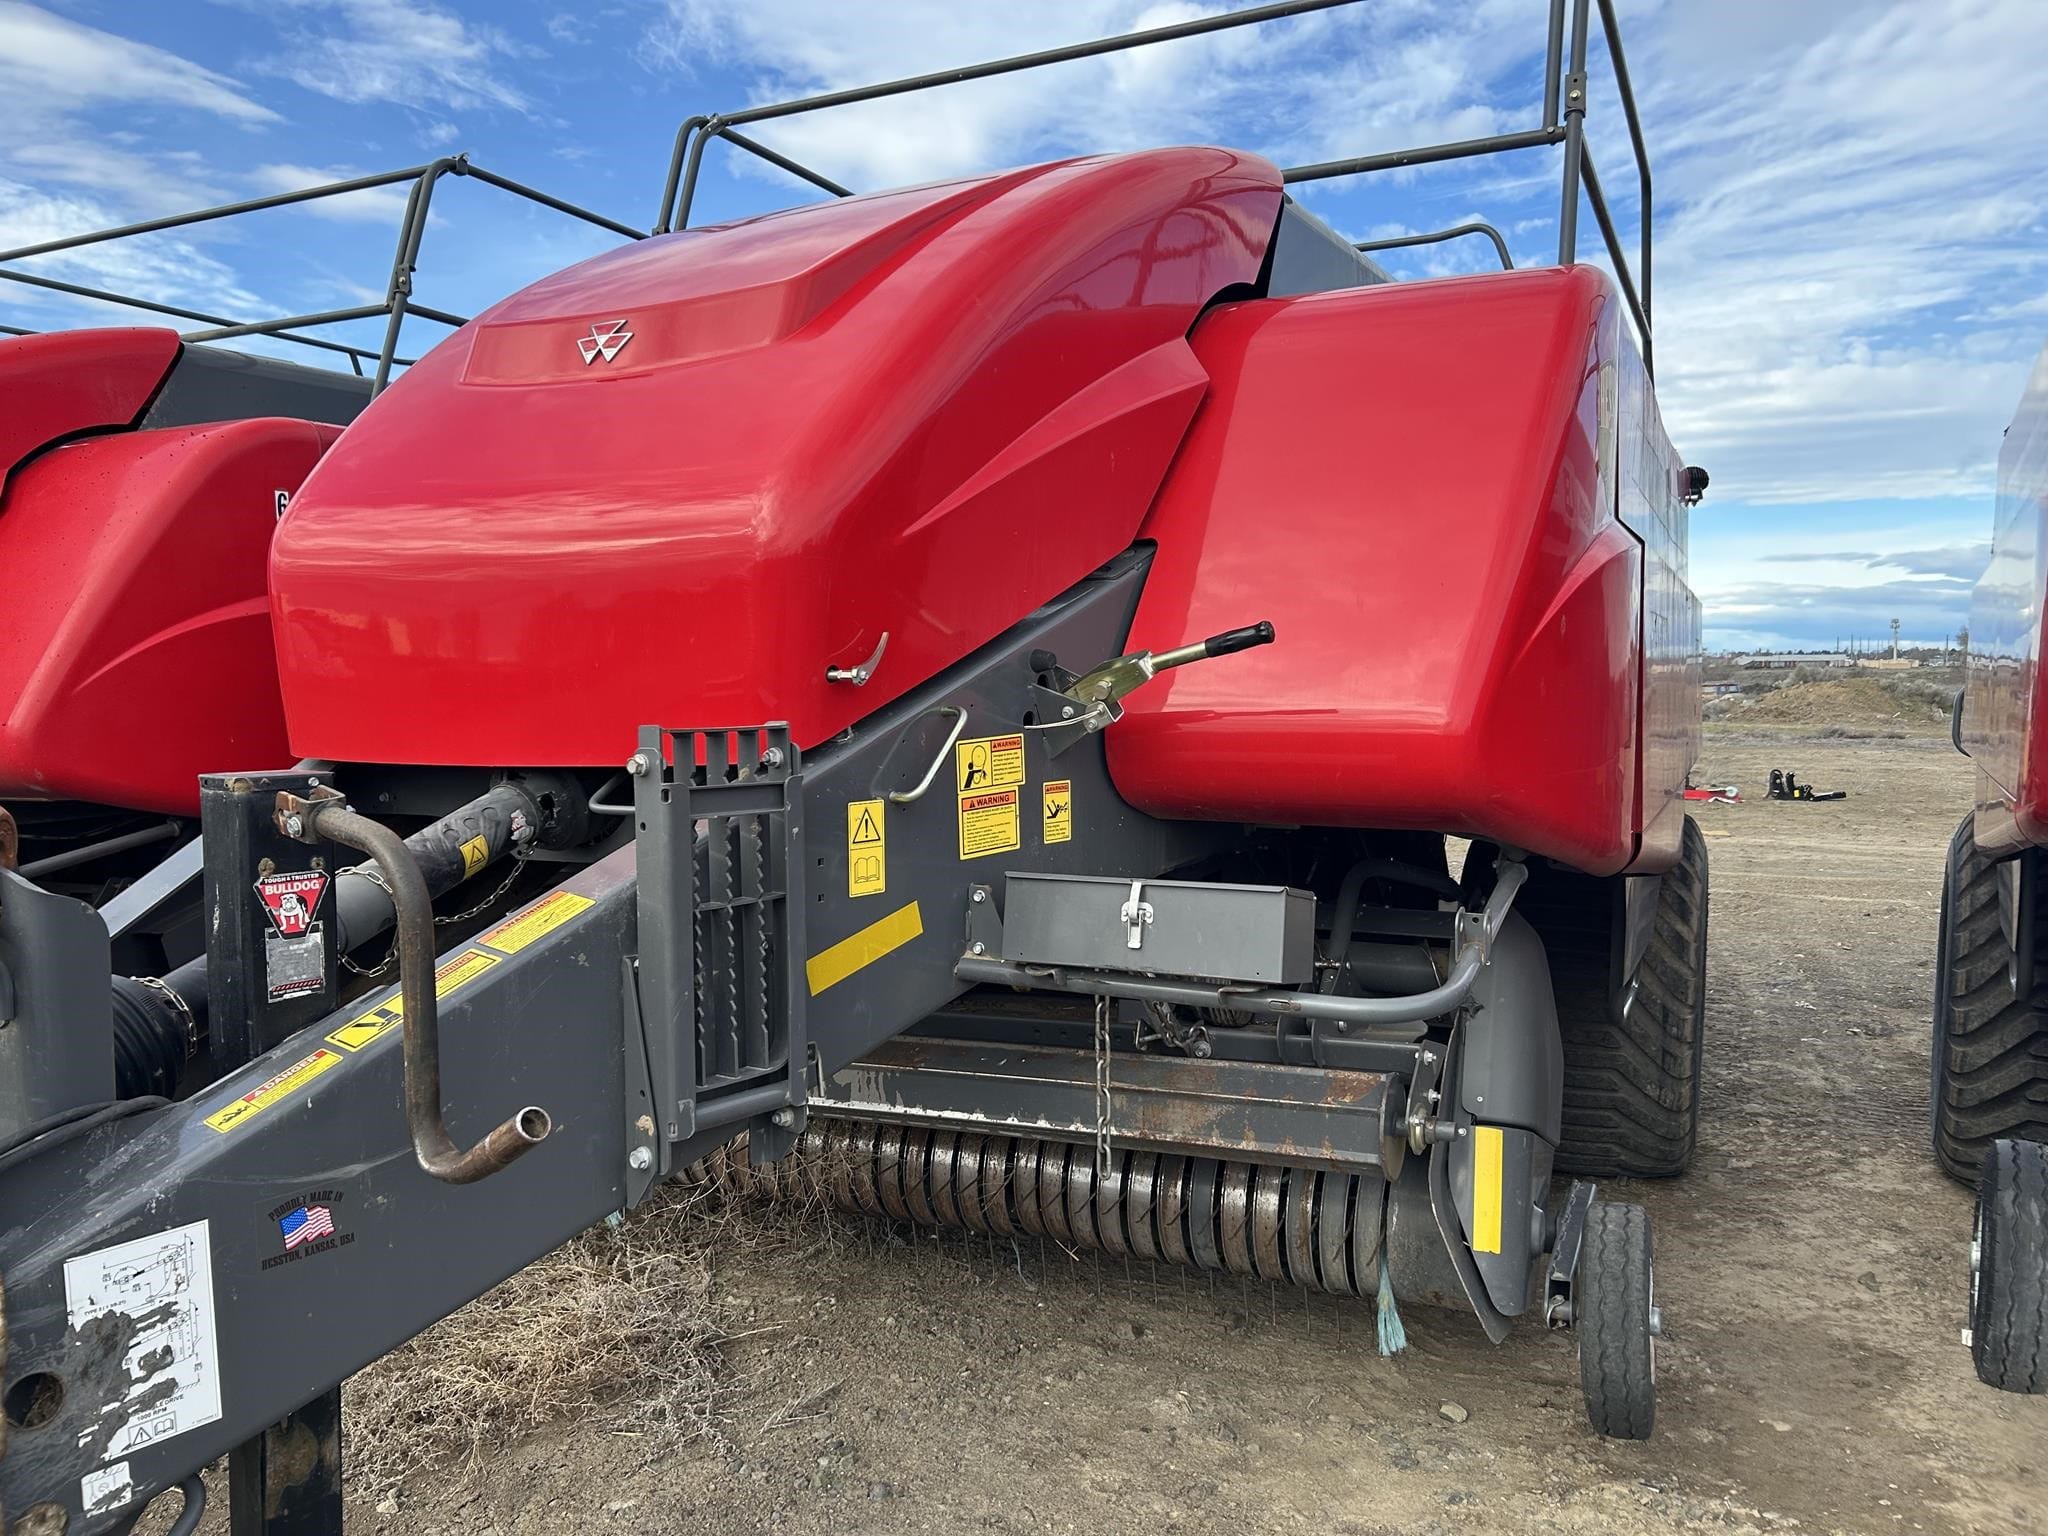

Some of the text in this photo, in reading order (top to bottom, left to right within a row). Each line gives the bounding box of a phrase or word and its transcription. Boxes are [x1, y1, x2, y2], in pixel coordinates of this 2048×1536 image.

[996, 739, 1020, 748] WARNING
[976, 794, 1010, 807] WARNING
[264, 876, 286, 884] TOUGH
[292, 873, 319, 881] TRUSTED
[265, 880, 319, 895] BULLDOG
[505, 899, 551, 927] WARNING
[436, 956, 471, 979] RNING
[266, 1055, 319, 1089] DANGER
[268, 1190, 345, 1221] PROUDLY MADE IN
[340, 1232, 355, 1246] USA
[164, 1394, 184, 1407] DRIVE
[137, 1412, 151, 1421] 1000
[152, 1406, 167, 1417] RPM
